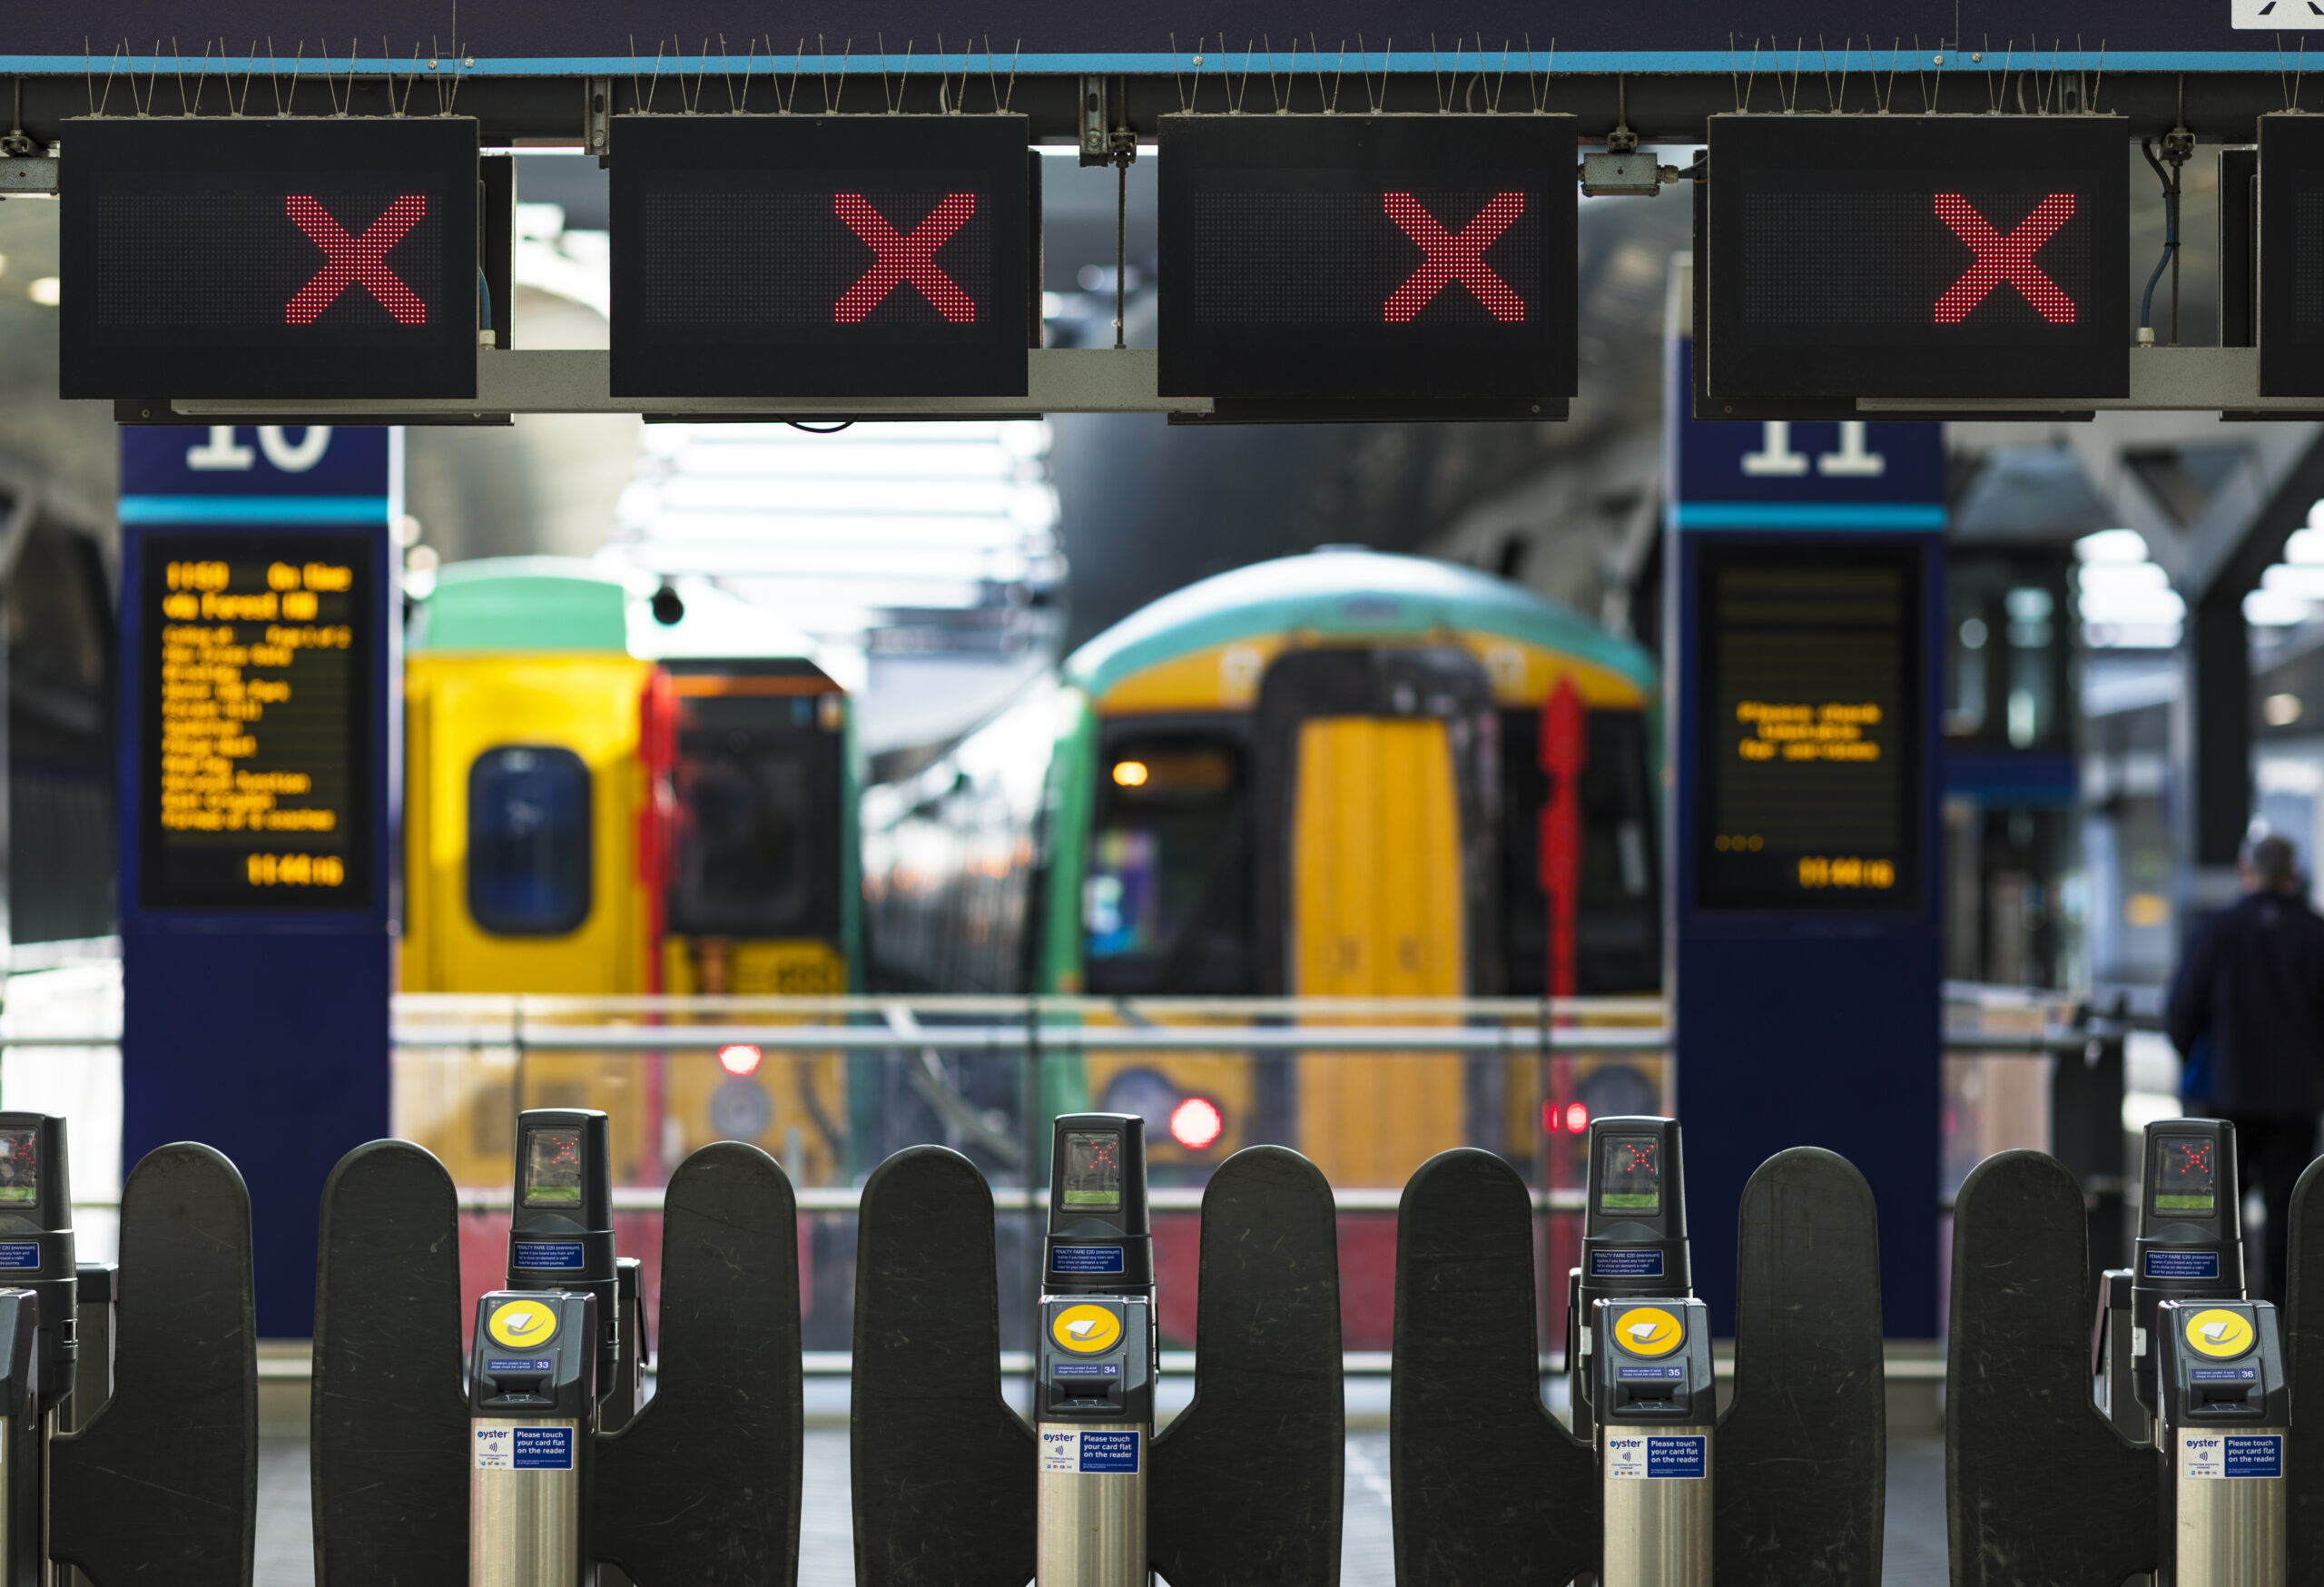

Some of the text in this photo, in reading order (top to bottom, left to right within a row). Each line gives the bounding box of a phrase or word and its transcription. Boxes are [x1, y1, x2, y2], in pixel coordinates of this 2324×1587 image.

[478, 1429, 508, 1440] oyster
[1043, 1433, 1074, 1444] oyster
[1610, 1439, 1641, 1450] oyster
[2186, 1439, 2219, 1449] oyster
